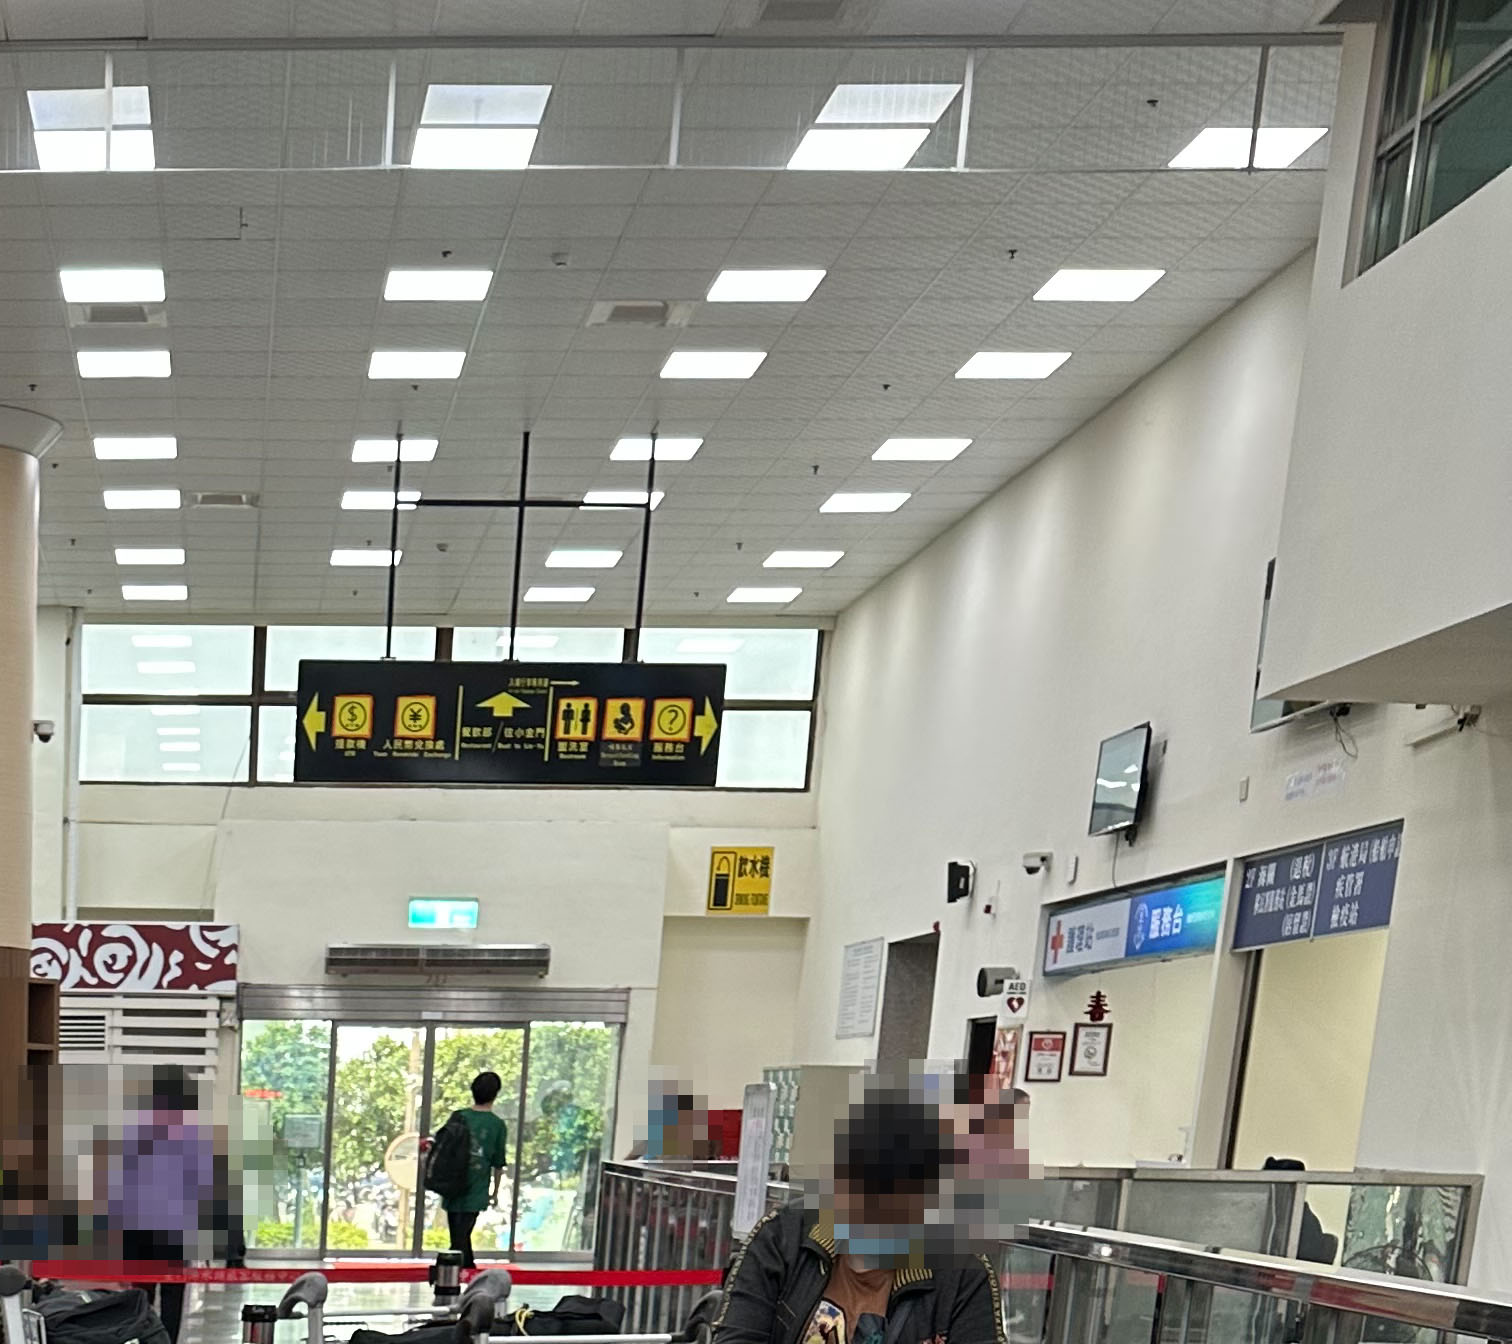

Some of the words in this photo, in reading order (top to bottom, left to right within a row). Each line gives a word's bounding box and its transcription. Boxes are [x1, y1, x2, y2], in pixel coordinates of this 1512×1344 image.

[1148, 903, 1184, 940] 服務台
[1008, 982, 1027, 991] AED
[1083, 989, 1112, 1022] 春
